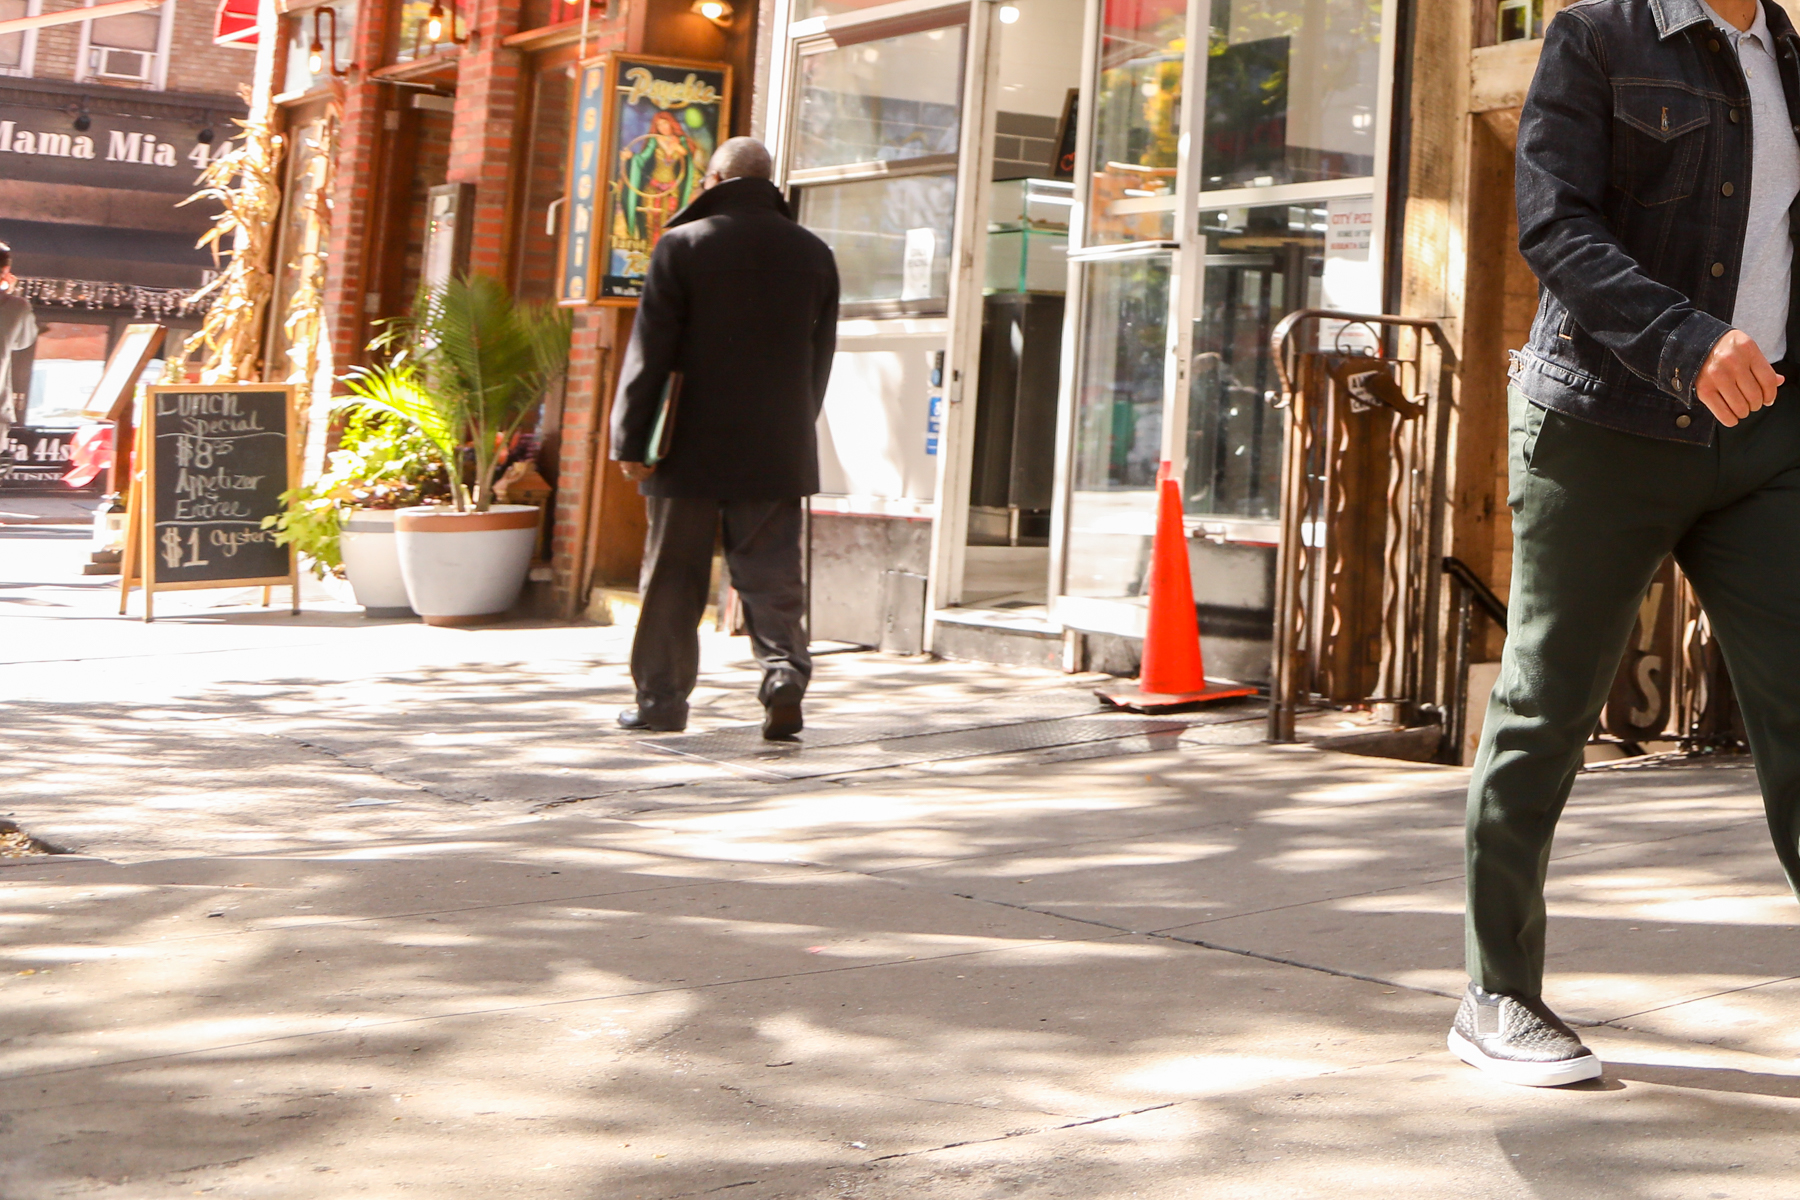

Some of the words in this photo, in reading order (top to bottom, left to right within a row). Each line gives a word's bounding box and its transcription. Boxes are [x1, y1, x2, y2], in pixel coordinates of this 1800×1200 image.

[625, 67, 717, 110] Psychic
[106, 130, 178, 168] Mia
[156, 392, 245, 417] Lunch
[181, 411, 265, 440] Special
[175, 466, 266, 501] Appetizer
[175, 499, 253, 520] Entree
[161, 526, 210, 569] $1
